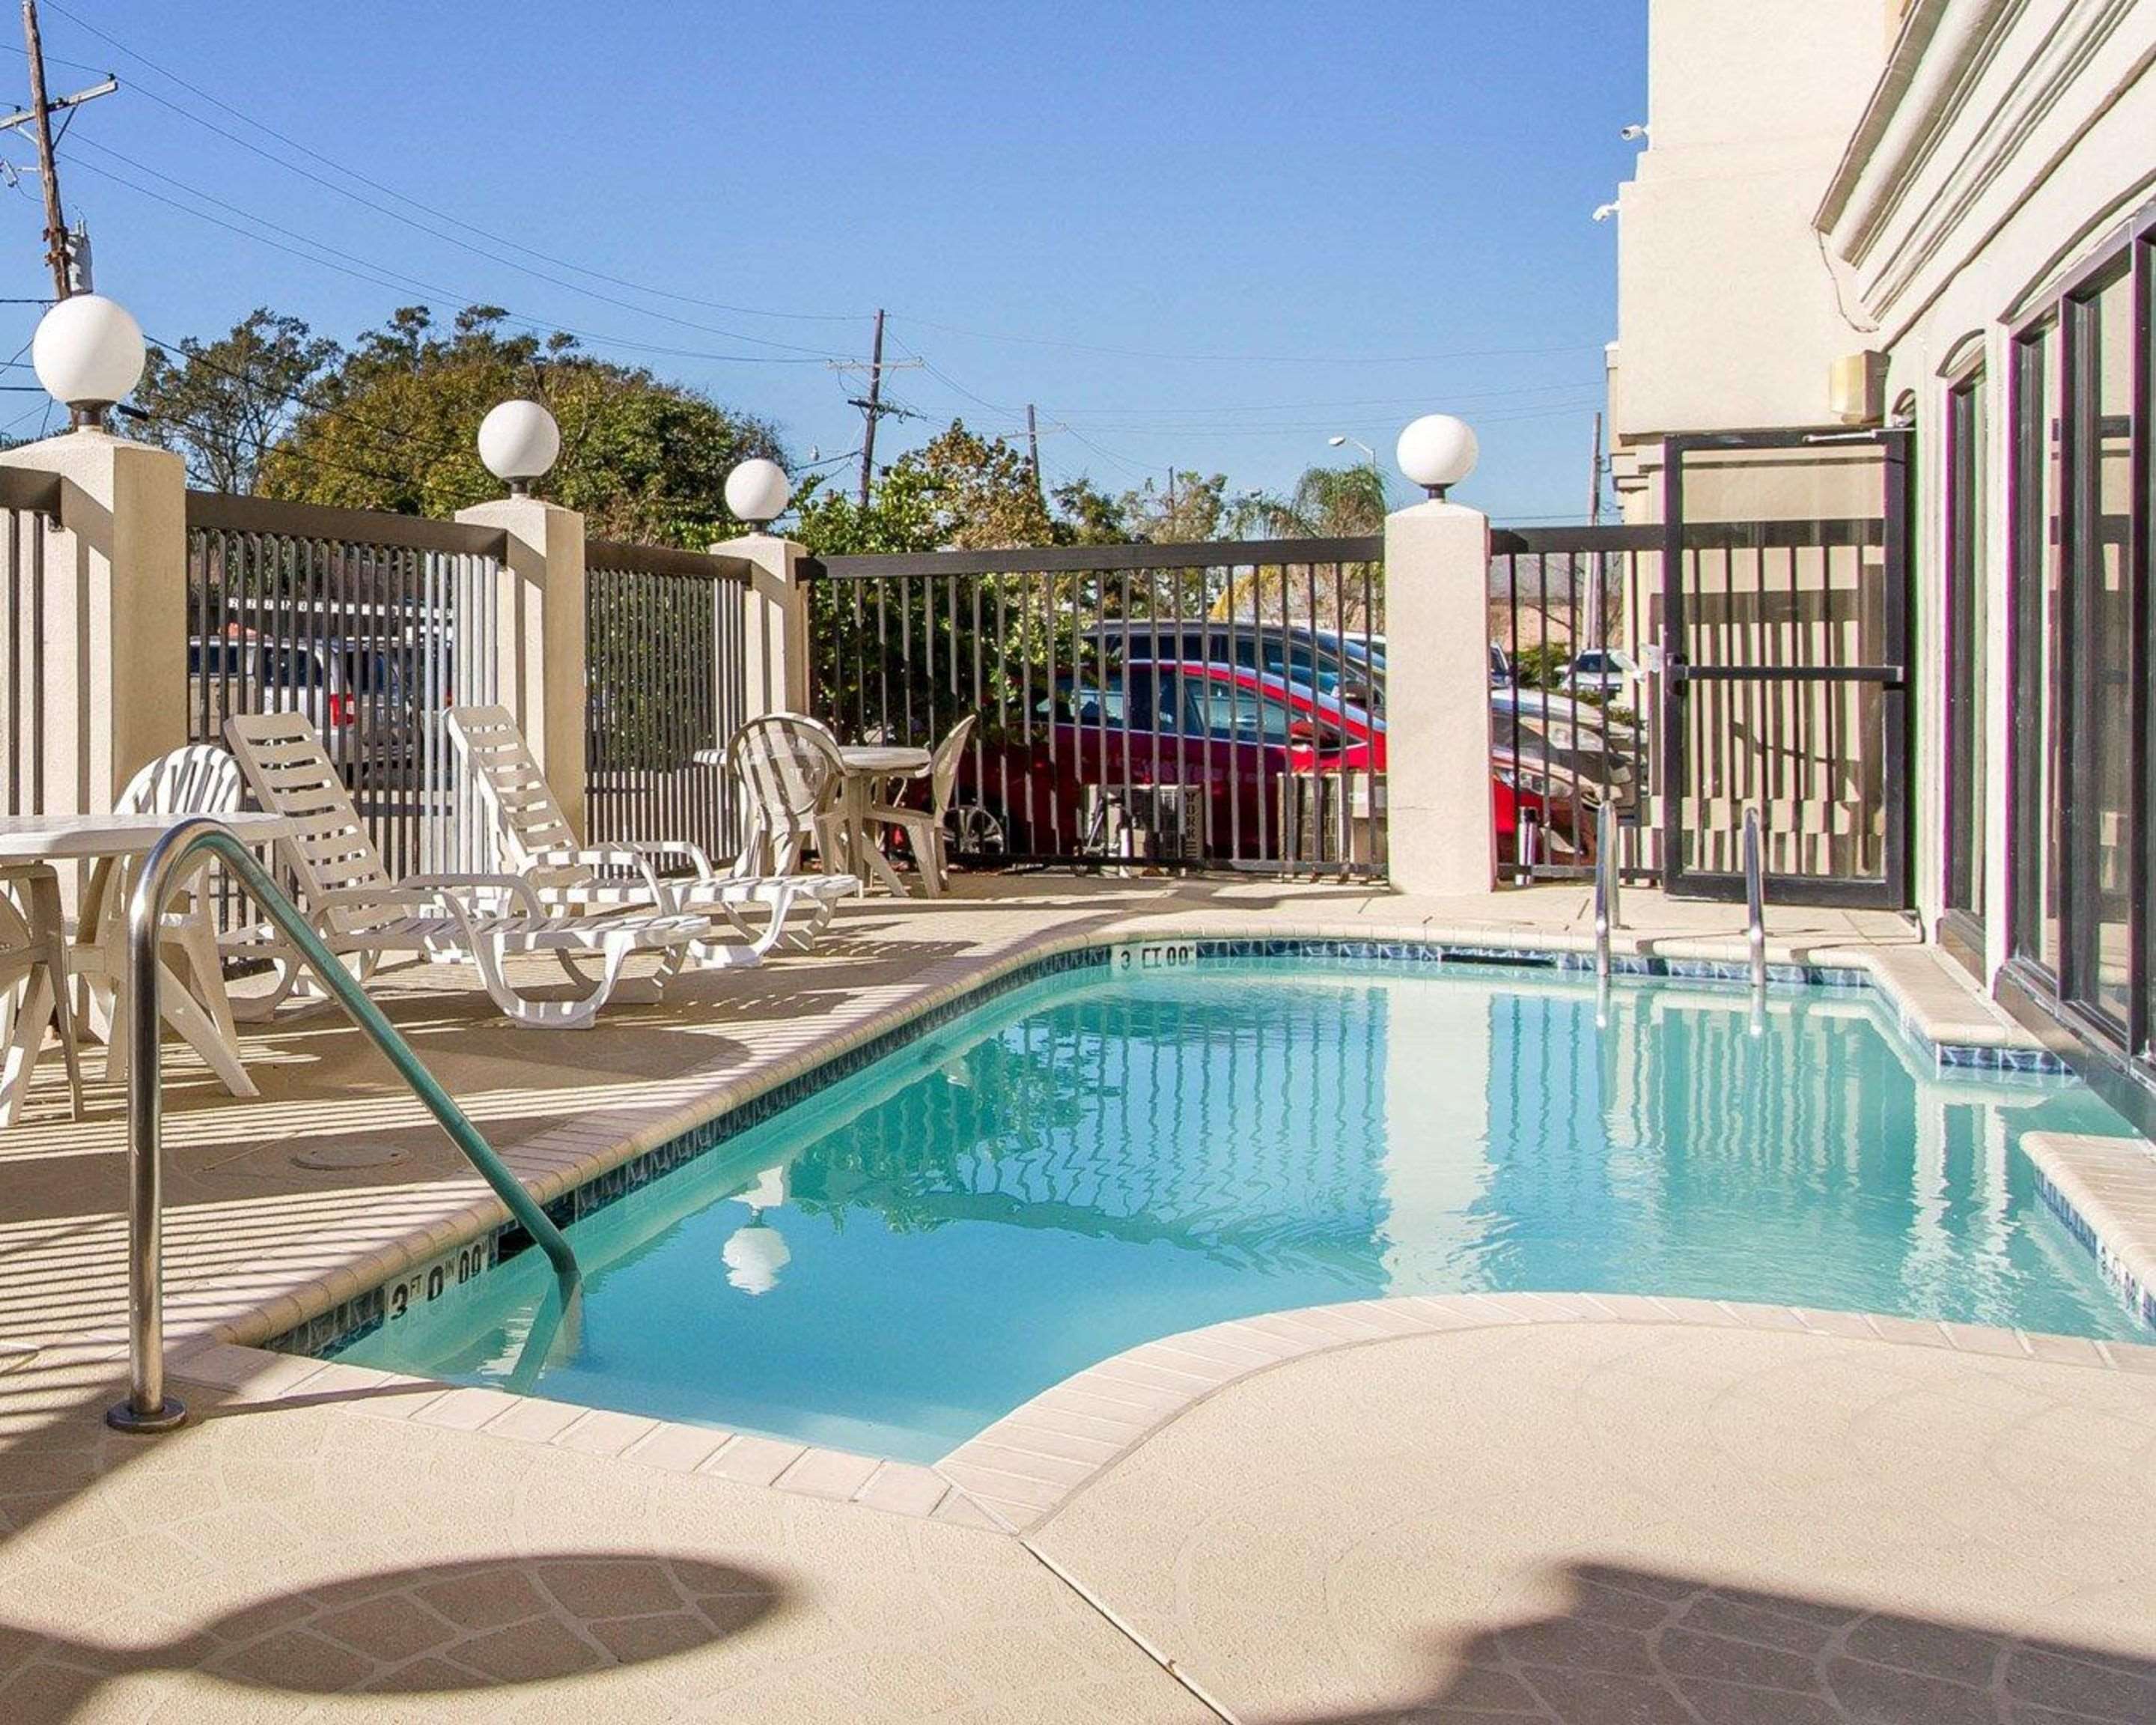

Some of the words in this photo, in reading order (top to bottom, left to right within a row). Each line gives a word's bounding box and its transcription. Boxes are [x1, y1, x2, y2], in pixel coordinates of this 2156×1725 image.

[1185, 792, 1196, 839] YORK
[1121, 949, 1131, 970] 3
[391, 1283, 408, 1320] 3
[410, 1274, 421, 1297] FT
[427, 1265, 444, 1301] 0
